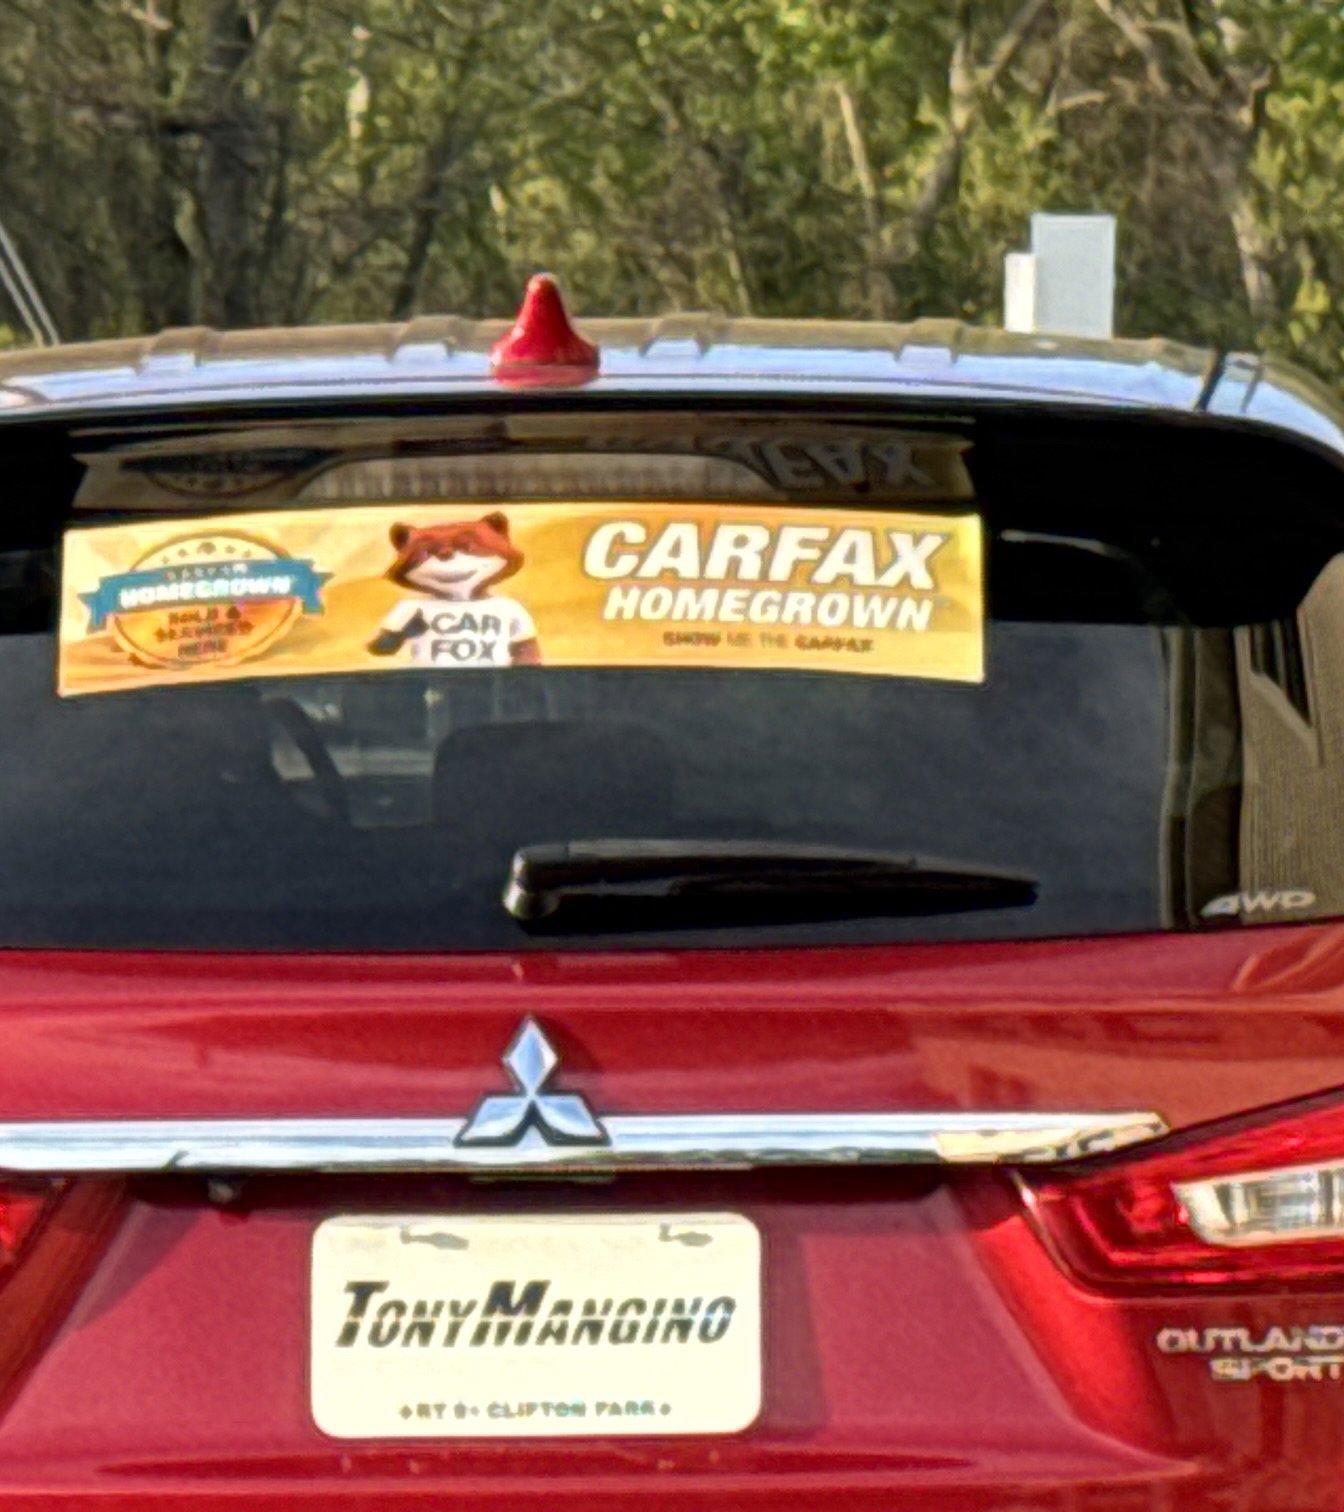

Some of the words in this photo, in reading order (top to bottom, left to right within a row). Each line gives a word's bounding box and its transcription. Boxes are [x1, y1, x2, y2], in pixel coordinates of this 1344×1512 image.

[582, 520, 947, 590] CARFAX
[119, 574, 293, 609] HOMEGROWN
[602, 585, 935, 632] HOMEGROWN
[430, 612, 502, 636] CAR
[430, 638, 497, 661] FOX
